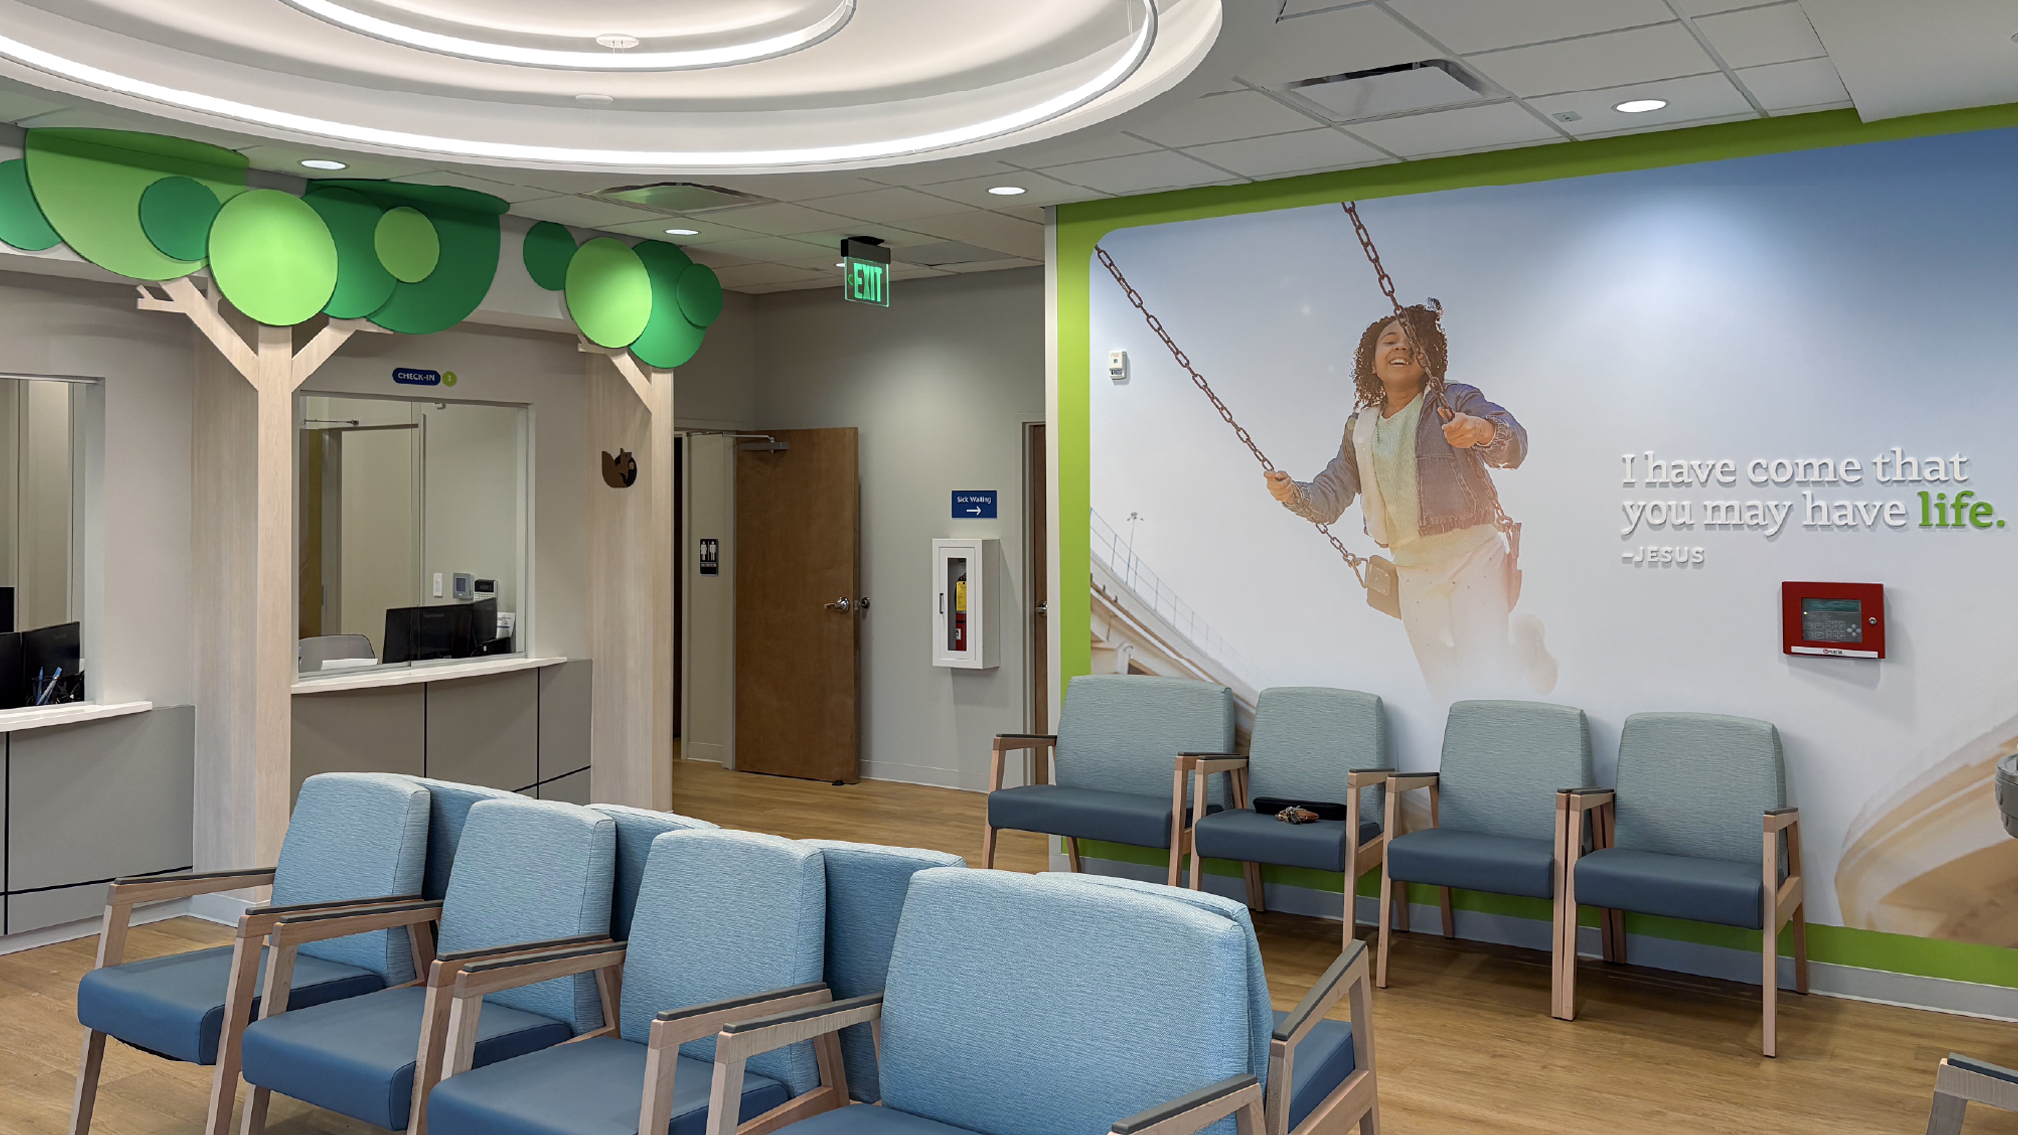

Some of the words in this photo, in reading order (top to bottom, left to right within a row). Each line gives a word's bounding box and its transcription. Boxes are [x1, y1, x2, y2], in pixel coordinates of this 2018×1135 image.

[853, 262, 883, 303] EXIT
[397, 372, 436, 382] CHECK-IN
[1621, 454, 1637, 484] I
[1644, 450, 1737, 484] have
[1747, 458, 1862, 483] come
[1872, 447, 1970, 483] that
[970, 496, 992, 504] Waiting
[1621, 500, 1695, 536] you
[1703, 500, 1793, 537] may
[1802, 490, 1908, 527] have
[1917, 490, 2006, 528] life.
